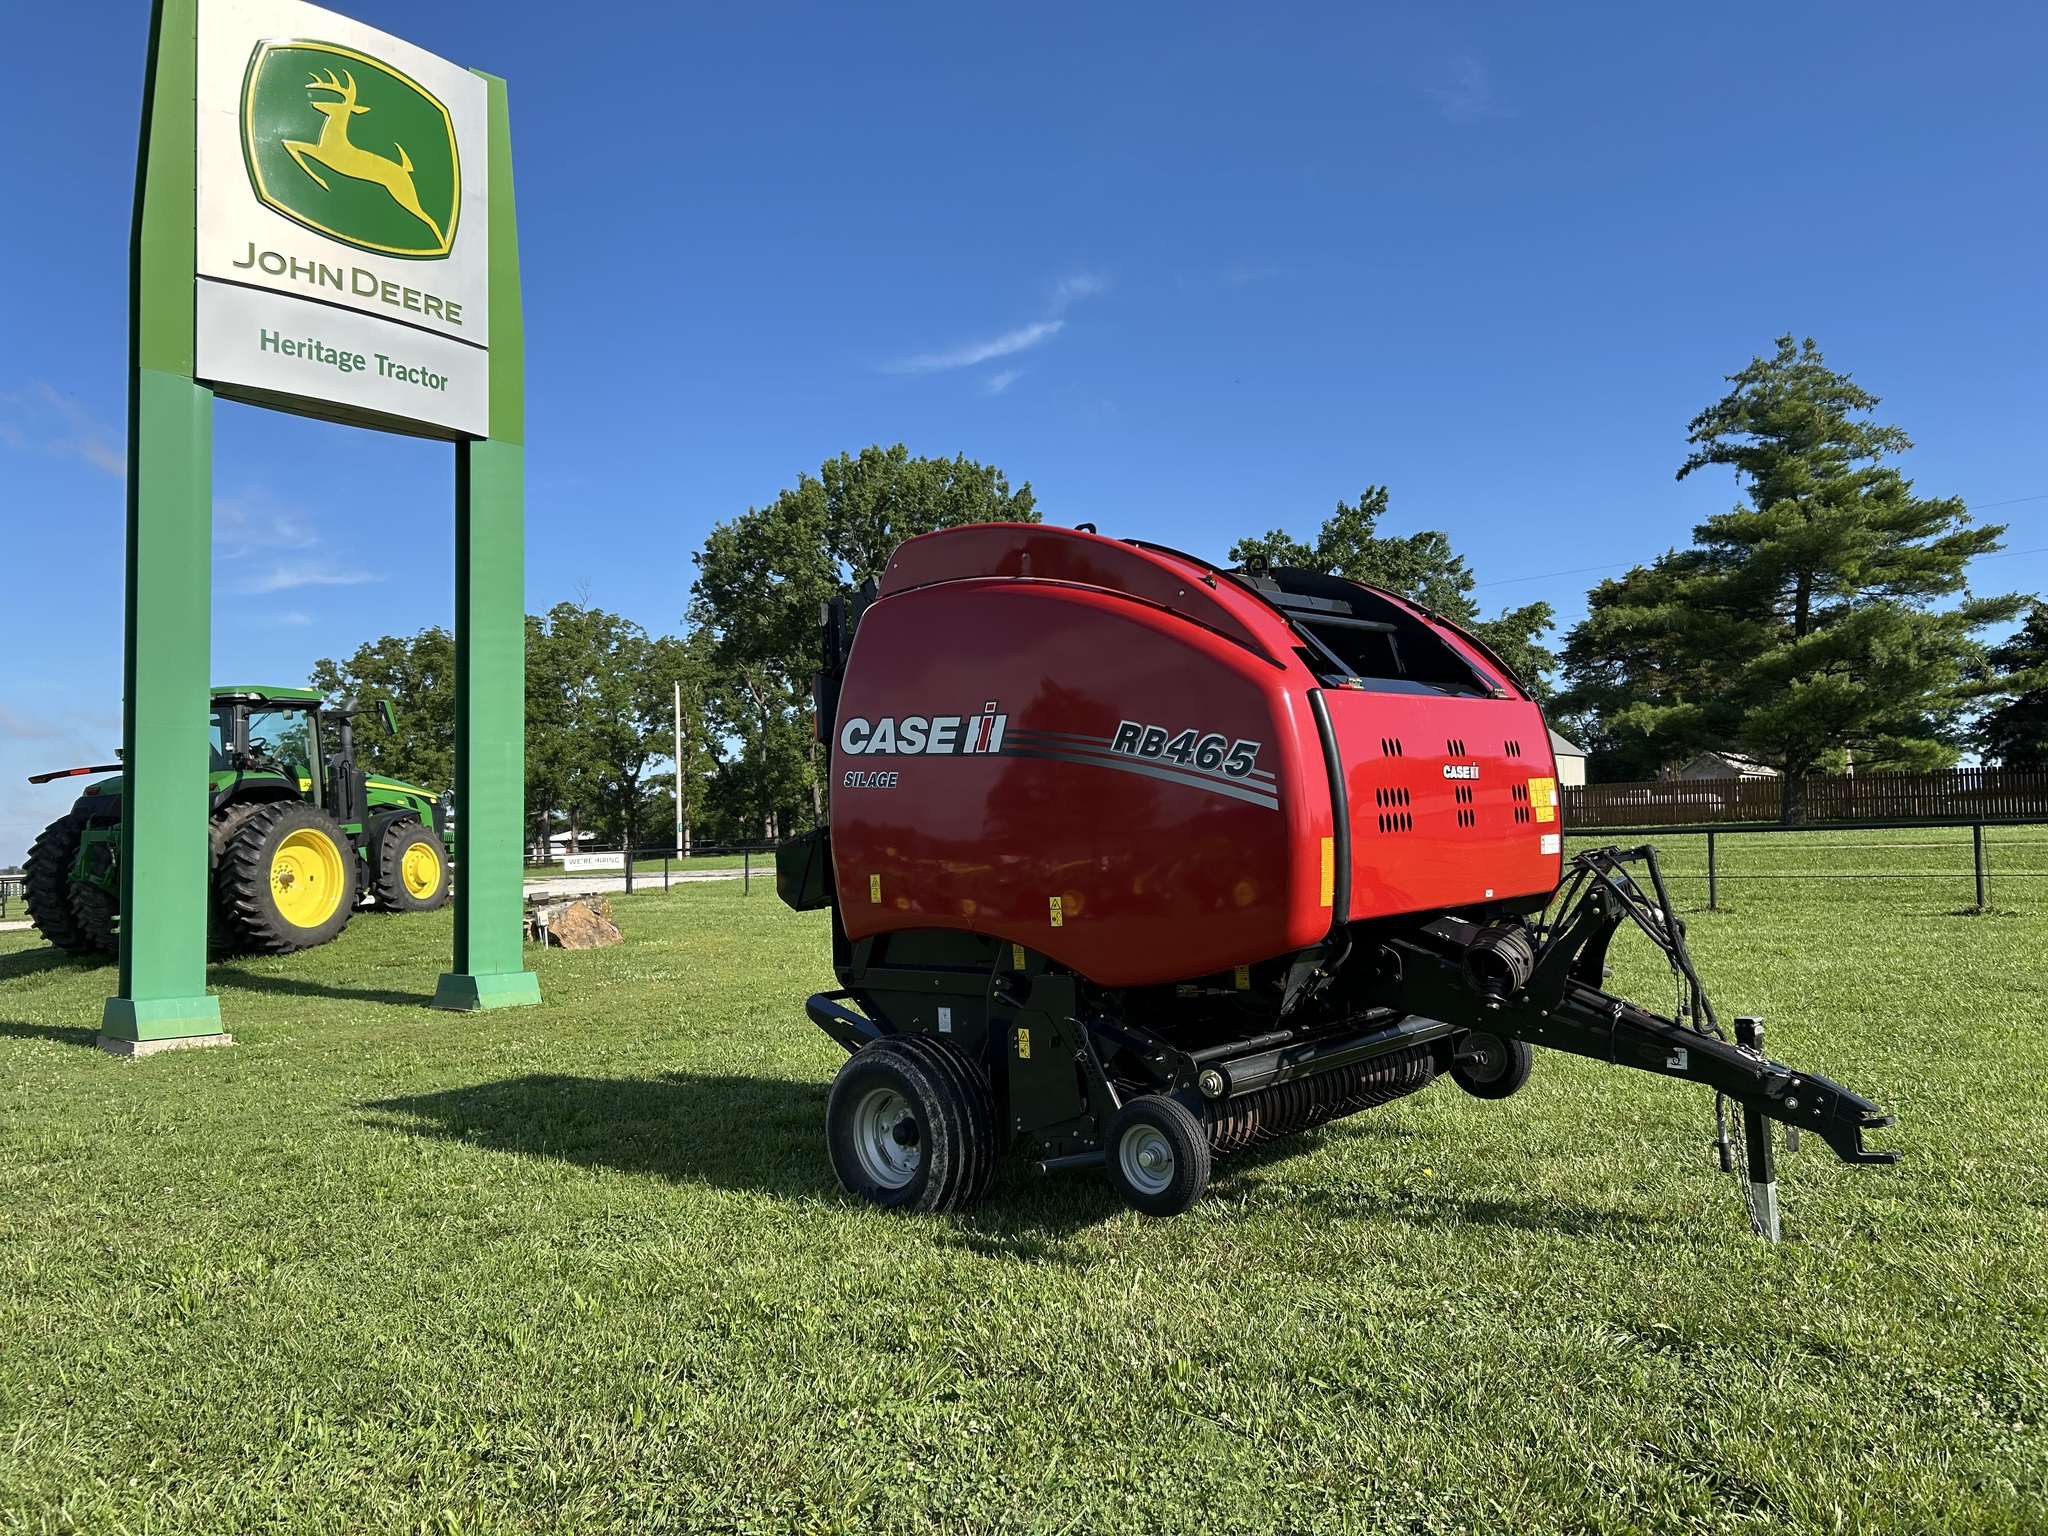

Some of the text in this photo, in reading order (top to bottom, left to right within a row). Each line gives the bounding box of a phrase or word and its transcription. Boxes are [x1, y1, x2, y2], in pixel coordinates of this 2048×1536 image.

[232, 242, 463, 326] JOHN DEERE
[260, 328, 448, 392] Heritage Tractor
[840, 716, 961, 755] CASE
[1110, 719, 1262, 779] RB465
[844, 771, 899, 789] SILAGE
[1442, 764, 1470, 779] CASE
